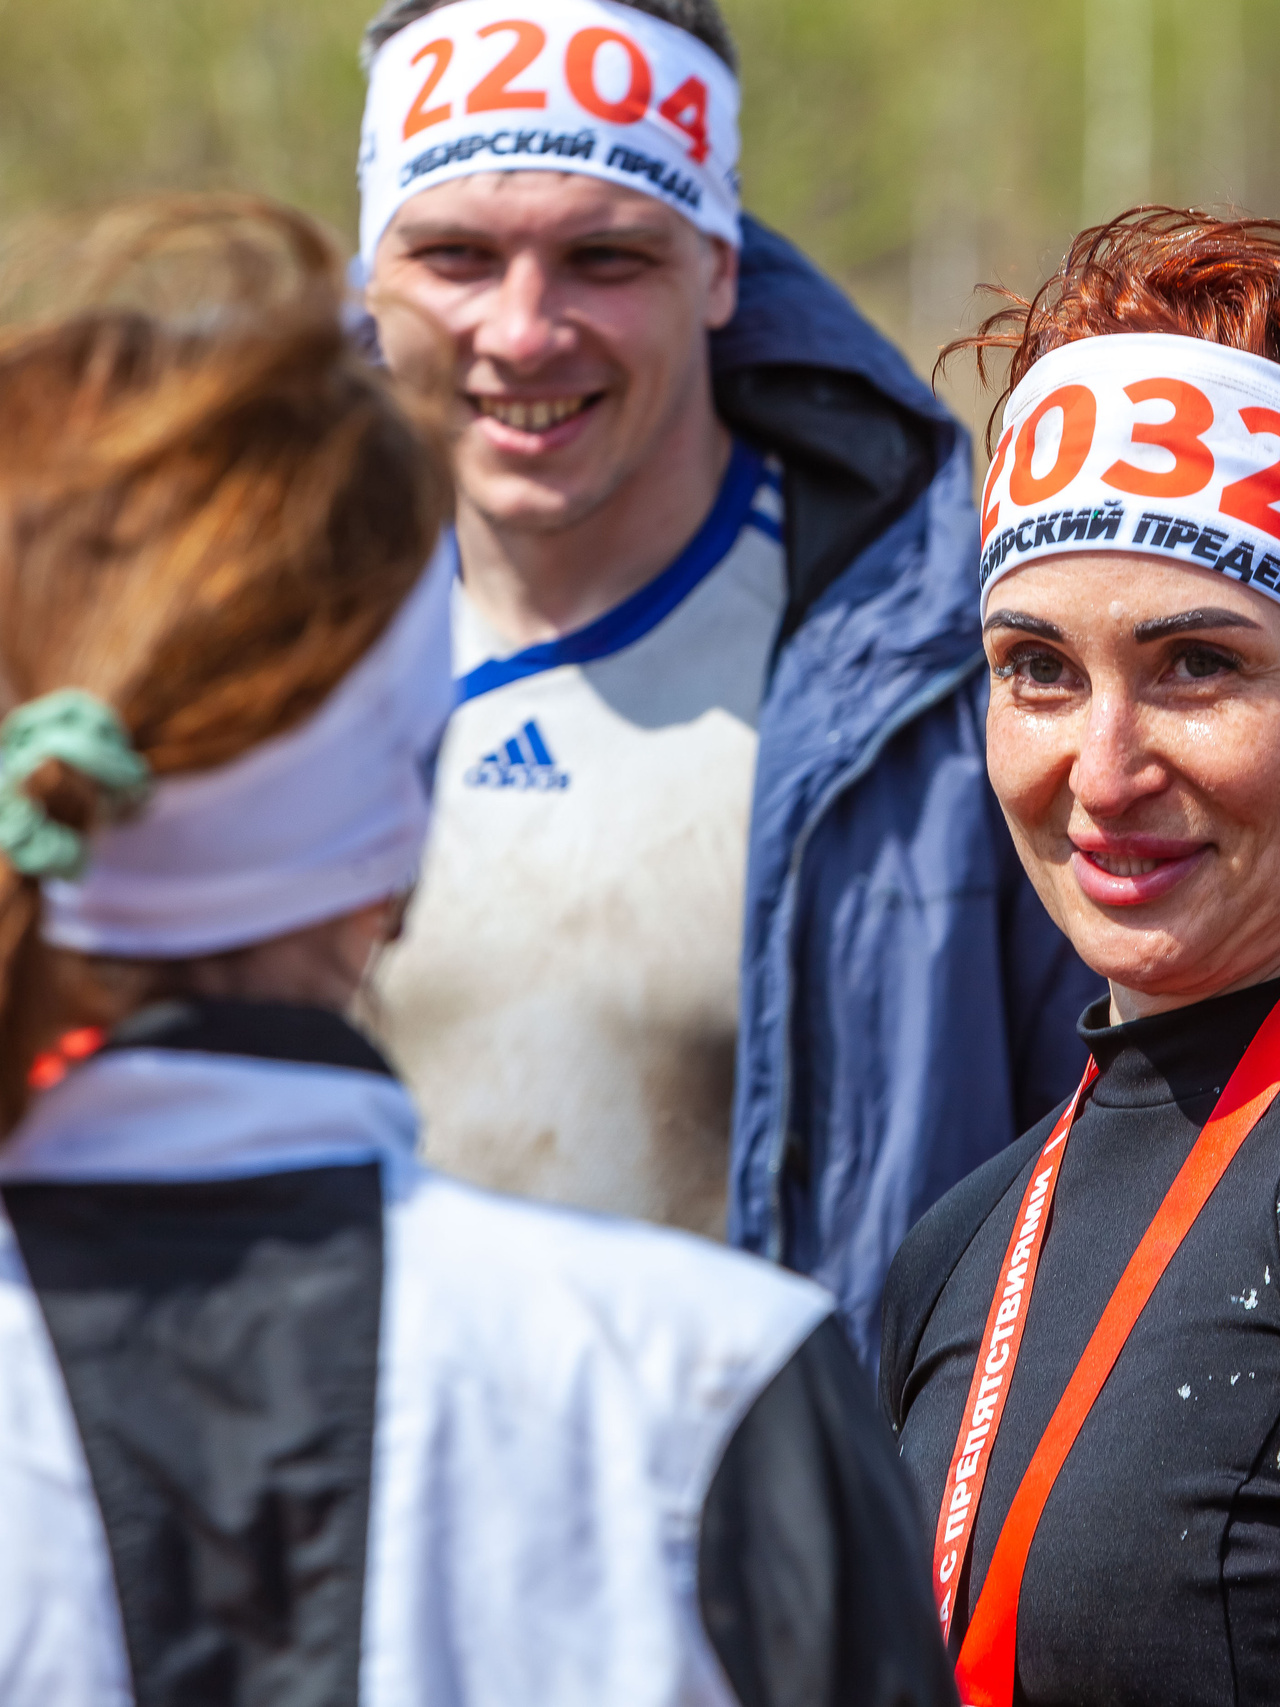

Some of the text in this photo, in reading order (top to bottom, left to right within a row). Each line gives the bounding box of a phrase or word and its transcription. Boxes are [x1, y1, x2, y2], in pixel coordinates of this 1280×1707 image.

[403, 19, 711, 166] 2204
[979, 499, 1125, 590] БИРСКИЙ
[943, 1165, 1054, 1544] ПРЕПЯТСТВИЯМИ
